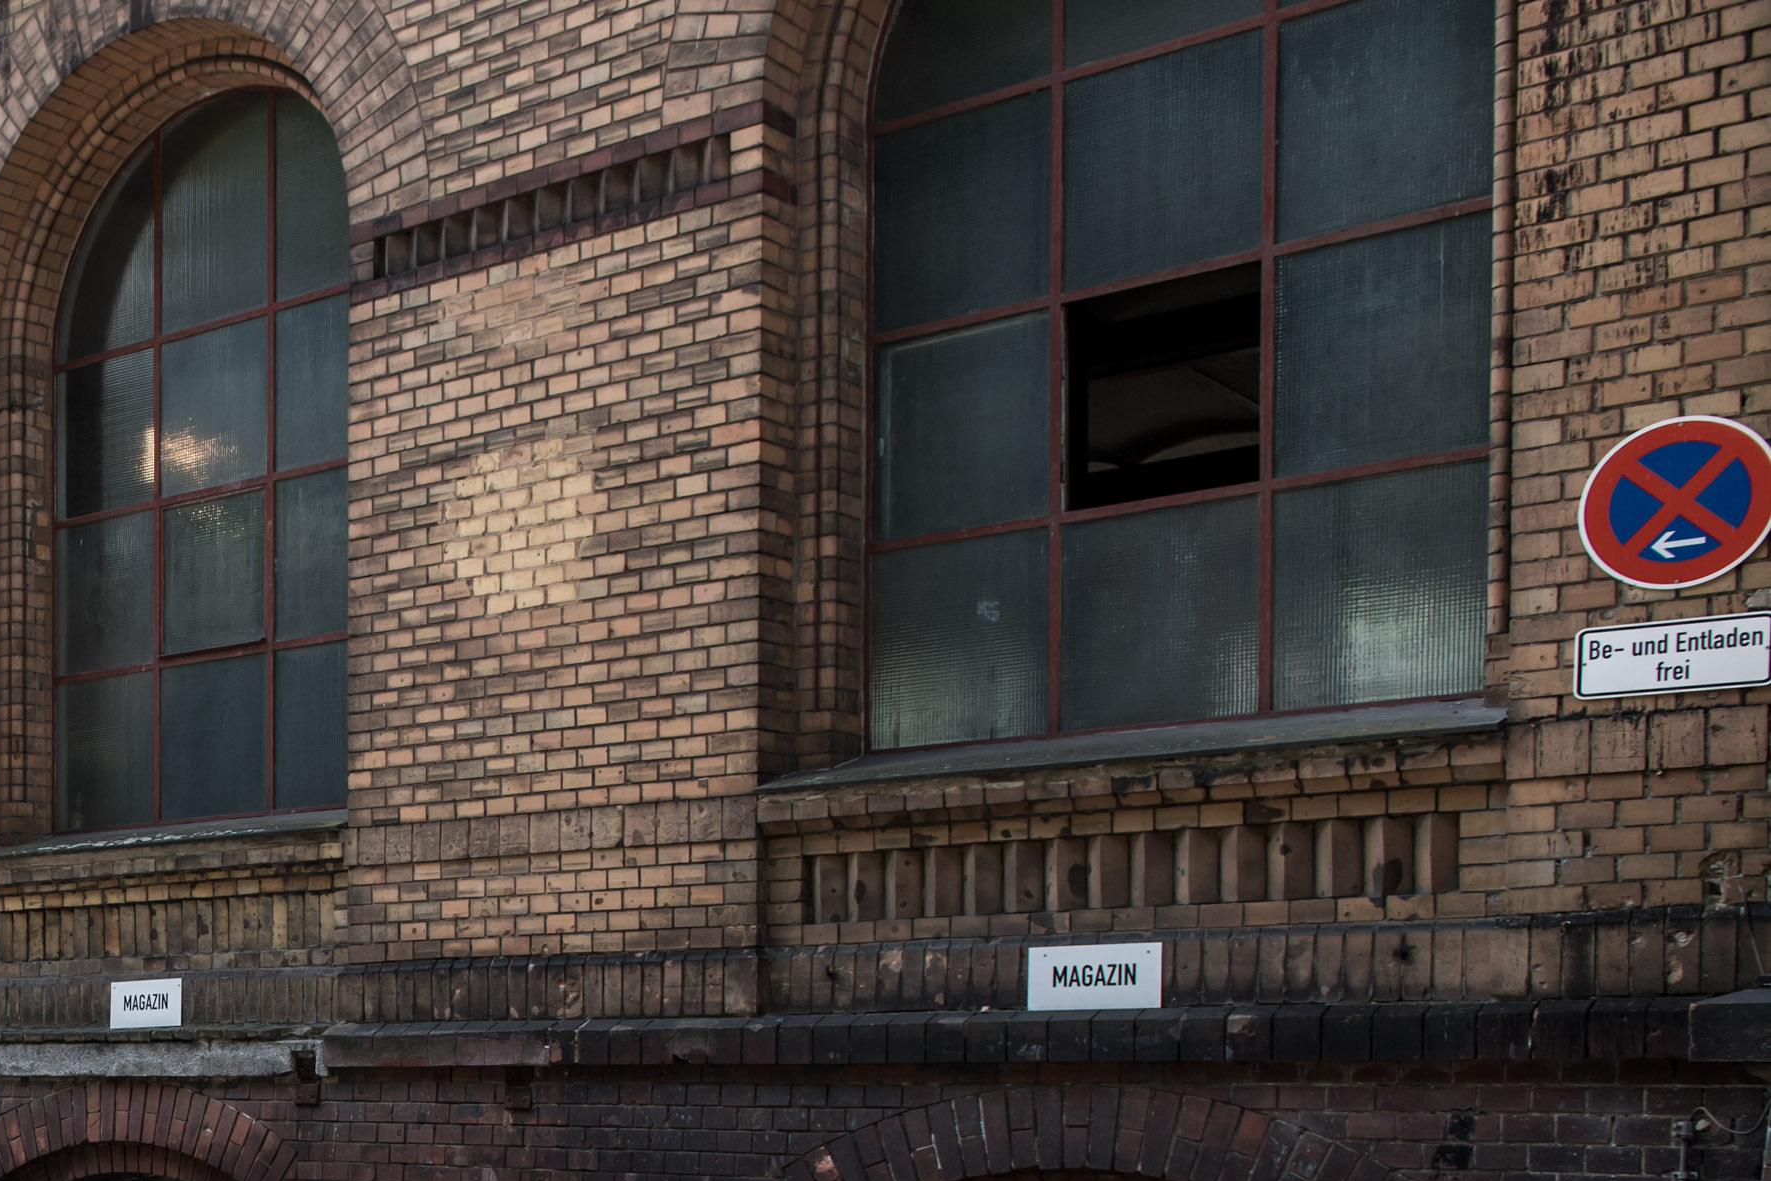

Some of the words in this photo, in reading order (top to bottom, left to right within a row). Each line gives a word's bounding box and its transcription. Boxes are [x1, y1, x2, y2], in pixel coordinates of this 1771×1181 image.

[1589, 639, 1624, 661] Be-
[1632, 633, 1668, 658] und
[1676, 627, 1764, 654] Entladen
[1656, 659, 1690, 683] frei
[1052, 963, 1137, 988] MAGAZIN
[123, 993, 169, 1012] MAGAZIN
